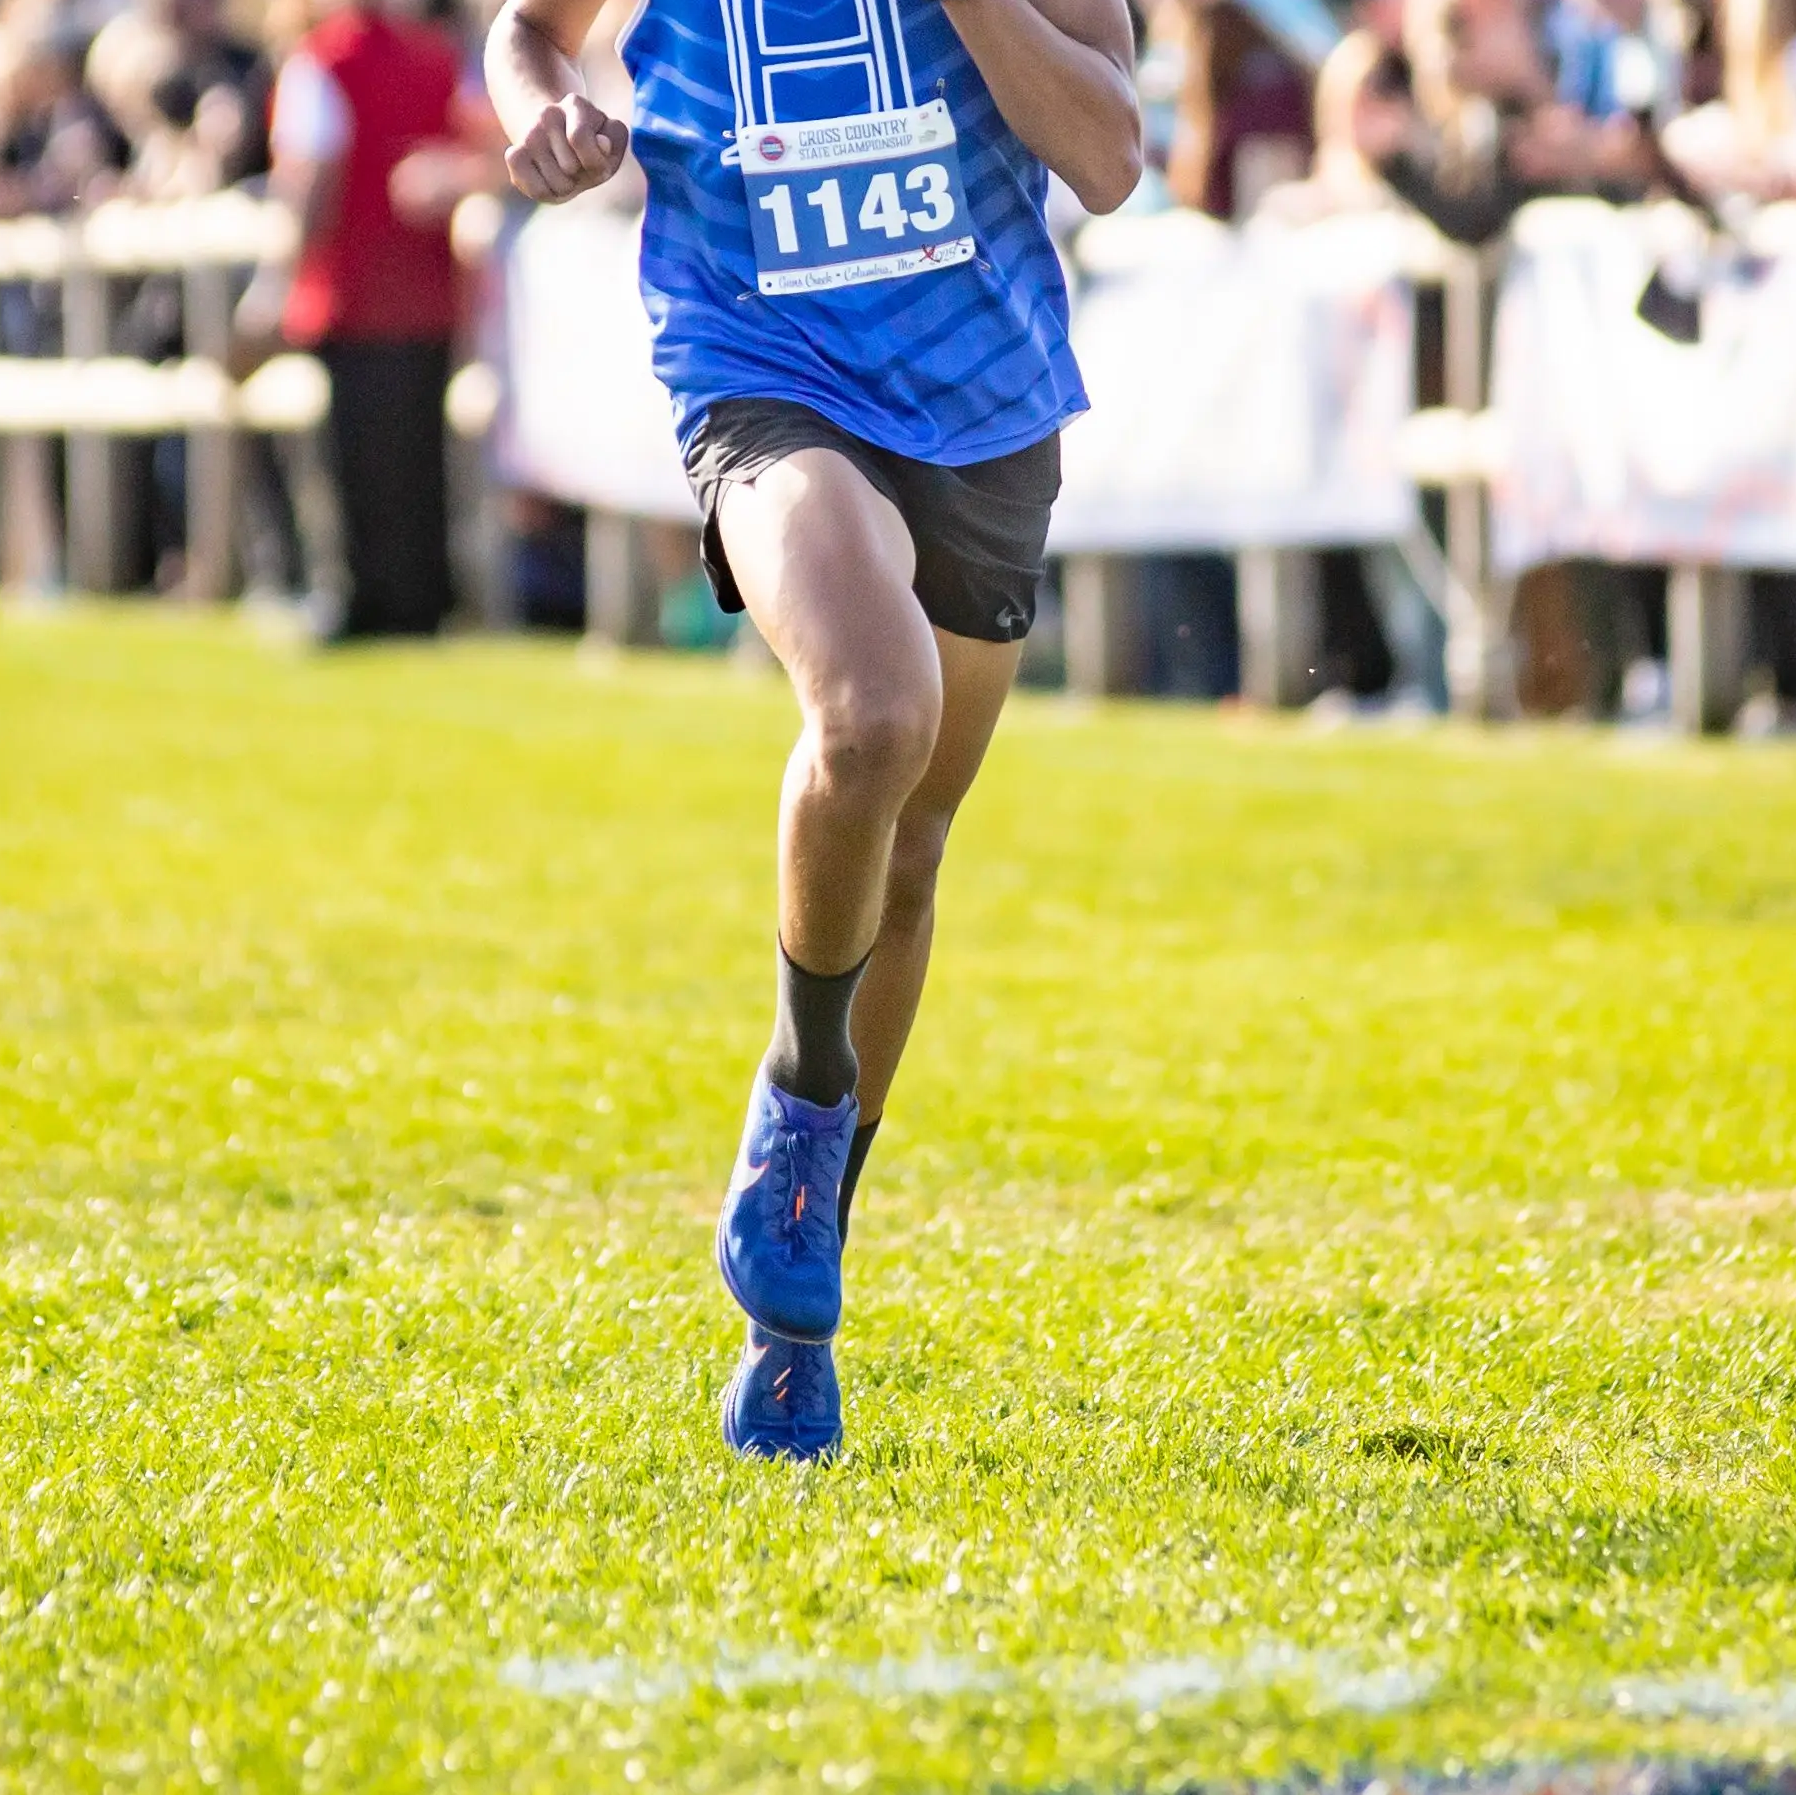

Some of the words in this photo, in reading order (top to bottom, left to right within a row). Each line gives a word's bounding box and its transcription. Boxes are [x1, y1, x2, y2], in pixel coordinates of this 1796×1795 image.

[798, 128, 841, 146] CROSS
[845, 118, 907, 140] COUNTRY
[798, 145, 830, 160] STATE
[833, 134, 913, 156] CHAMPIONSHIP
[759, 163, 954, 253] 1143
